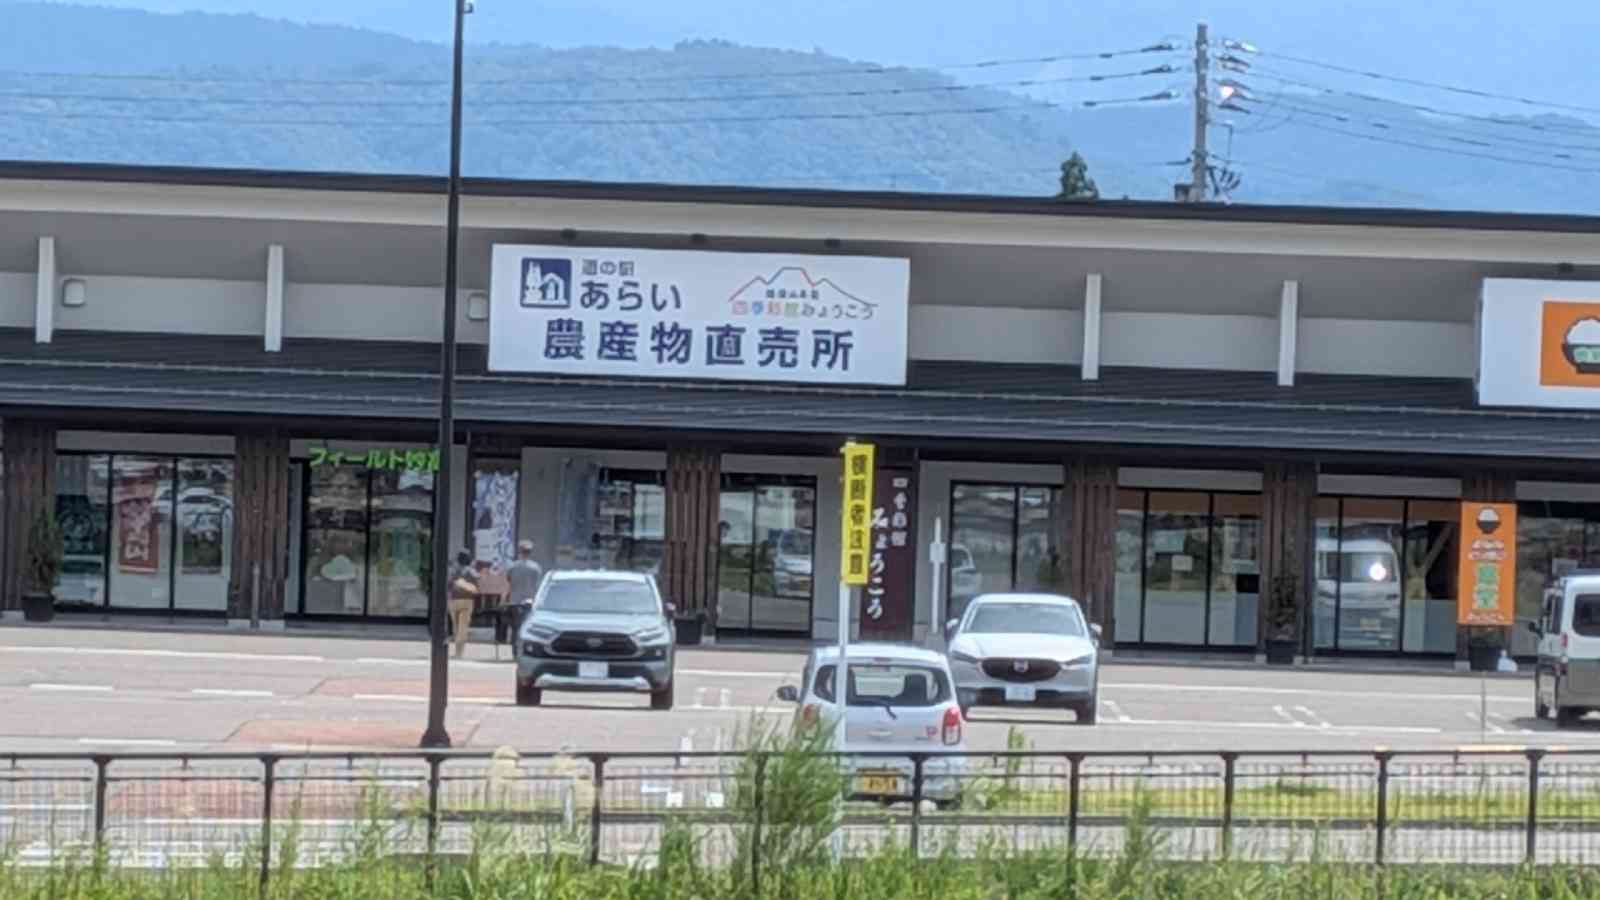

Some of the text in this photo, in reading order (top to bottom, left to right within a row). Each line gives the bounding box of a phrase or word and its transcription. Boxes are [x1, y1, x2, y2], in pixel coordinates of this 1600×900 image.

[580, 281, 682, 312] あらい
[543, 317, 855, 372] 農産物直売所
